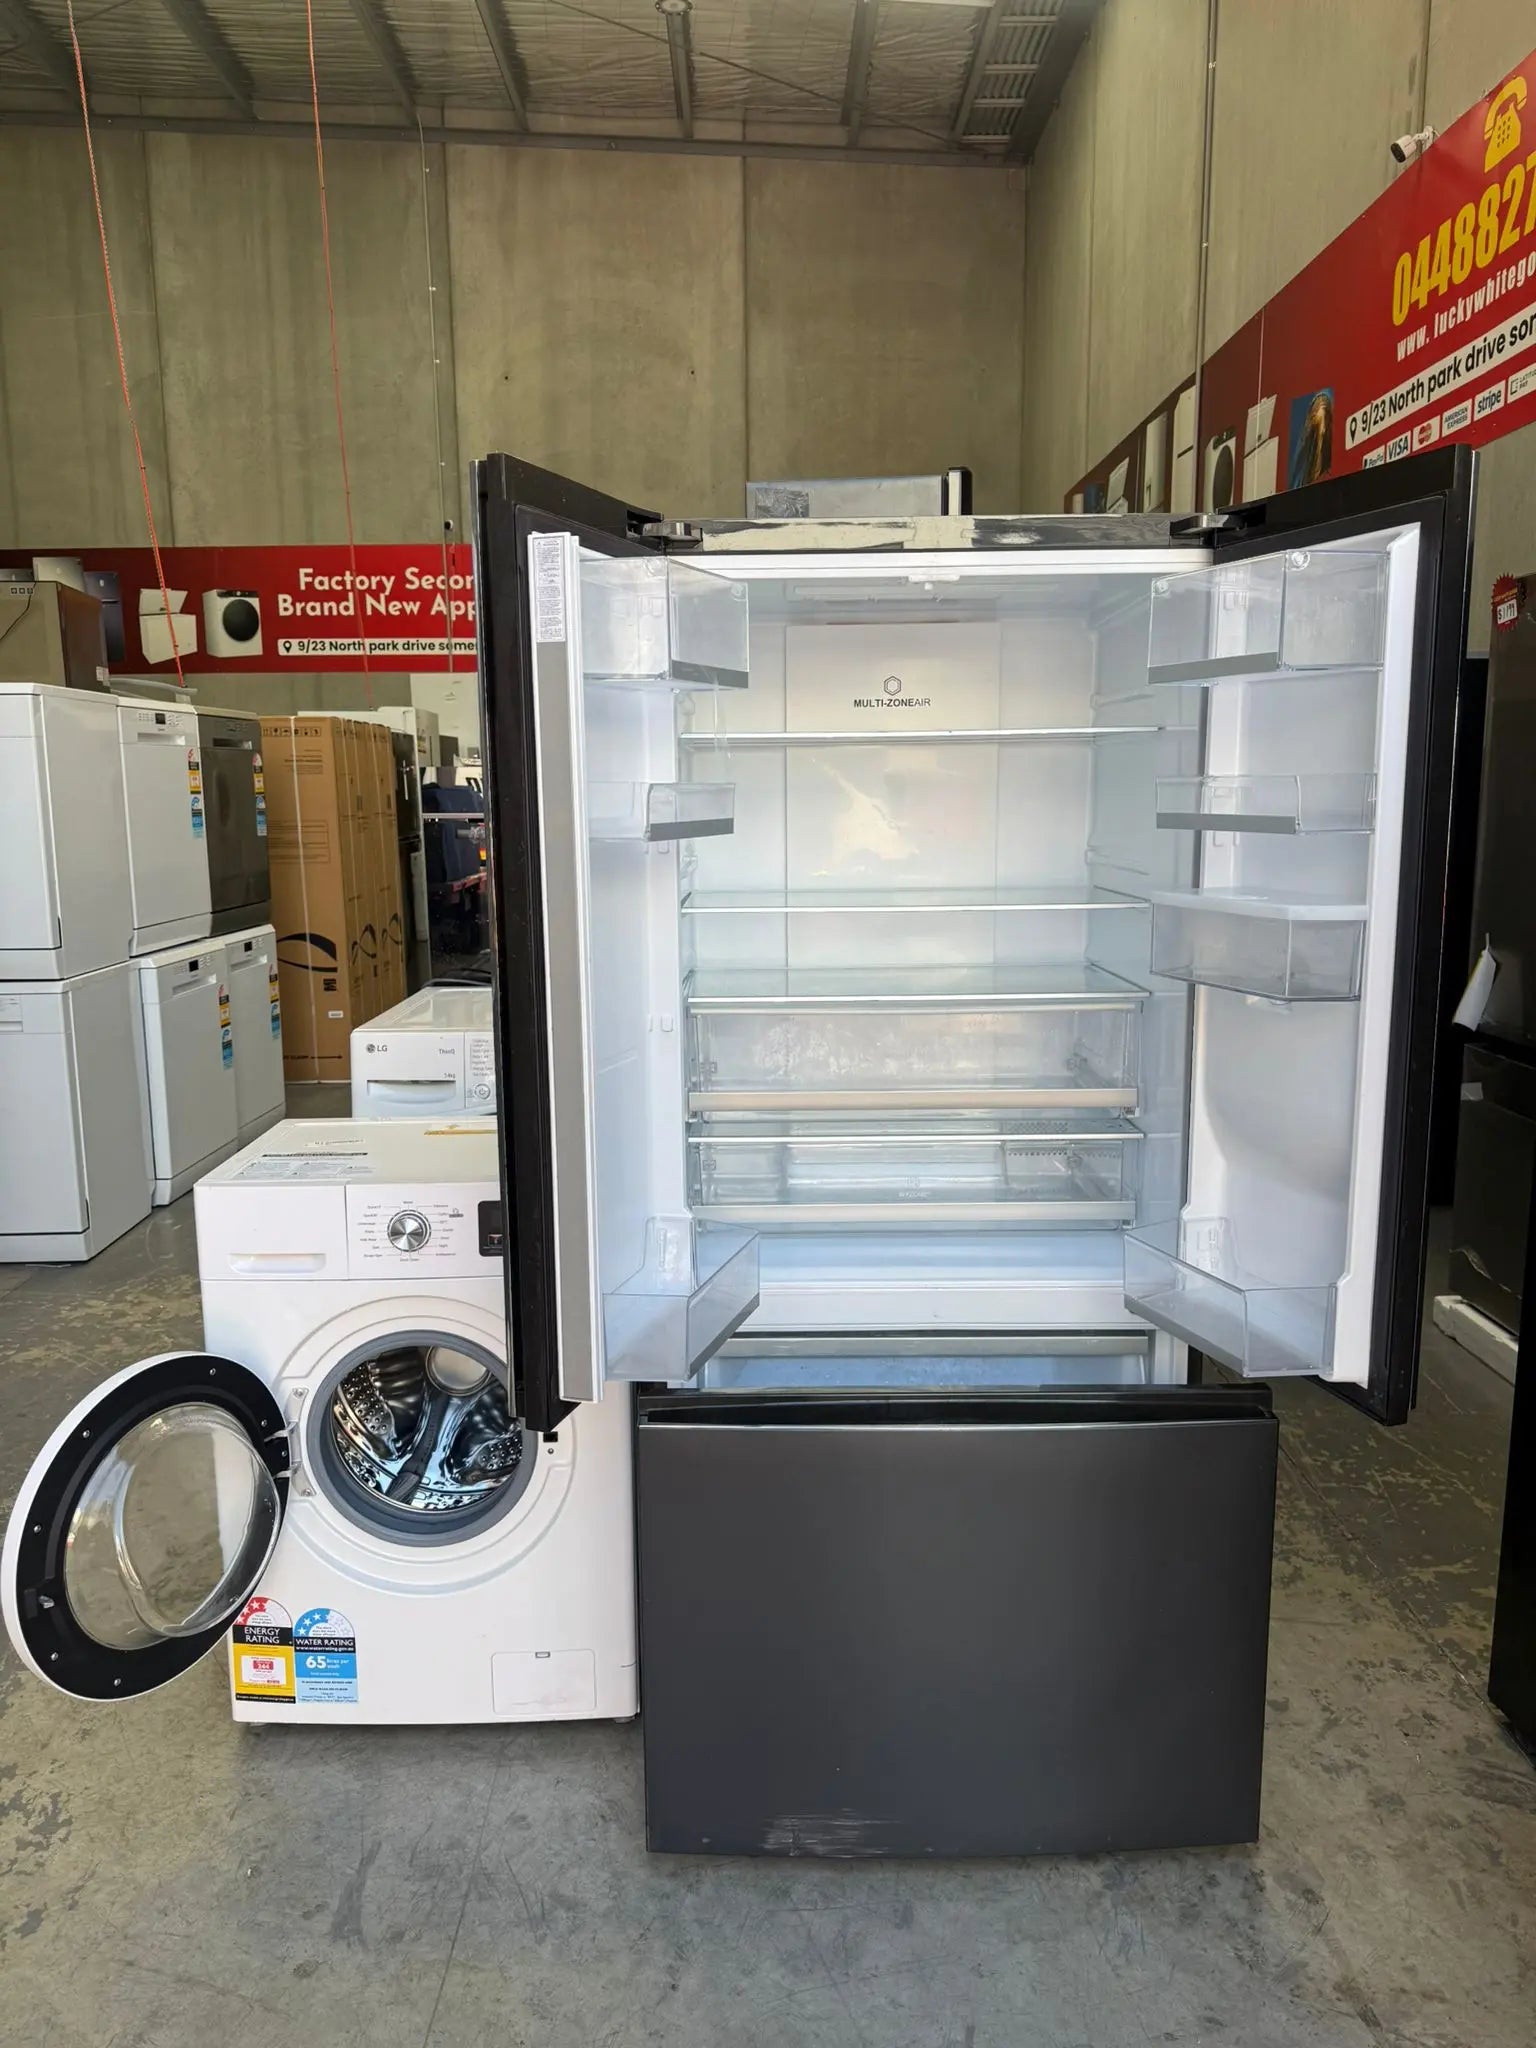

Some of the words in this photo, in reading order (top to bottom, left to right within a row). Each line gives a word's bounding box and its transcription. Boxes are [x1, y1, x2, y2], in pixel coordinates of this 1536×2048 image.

[1362, 399, 1386, 434] 9/23
[1389, 378, 1425, 417] North
[1428, 354, 1462, 402] park
[1465, 333, 1506, 372] drive
[1477, 390, 1502, 414] stripe
[1388, 435, 1409, 460] VISA
[299, 568, 395, 595] Factory
[278, 592, 355, 616] Brand
[365, 593, 421, 616] New
[298, 640, 326, 653] 9/23
[329, 640, 365, 652] North
[369, 640, 399, 654] park
[402, 639, 436, 652] drive
[853, 698, 931, 708] MULTI-ZONEAIR
[244, 1626, 280, 1636] ENERGY
[245, 1635, 280, 1644] RATING
[324, 1639, 354, 1647] RATING
[305, 1655, 327, 1669] 65
